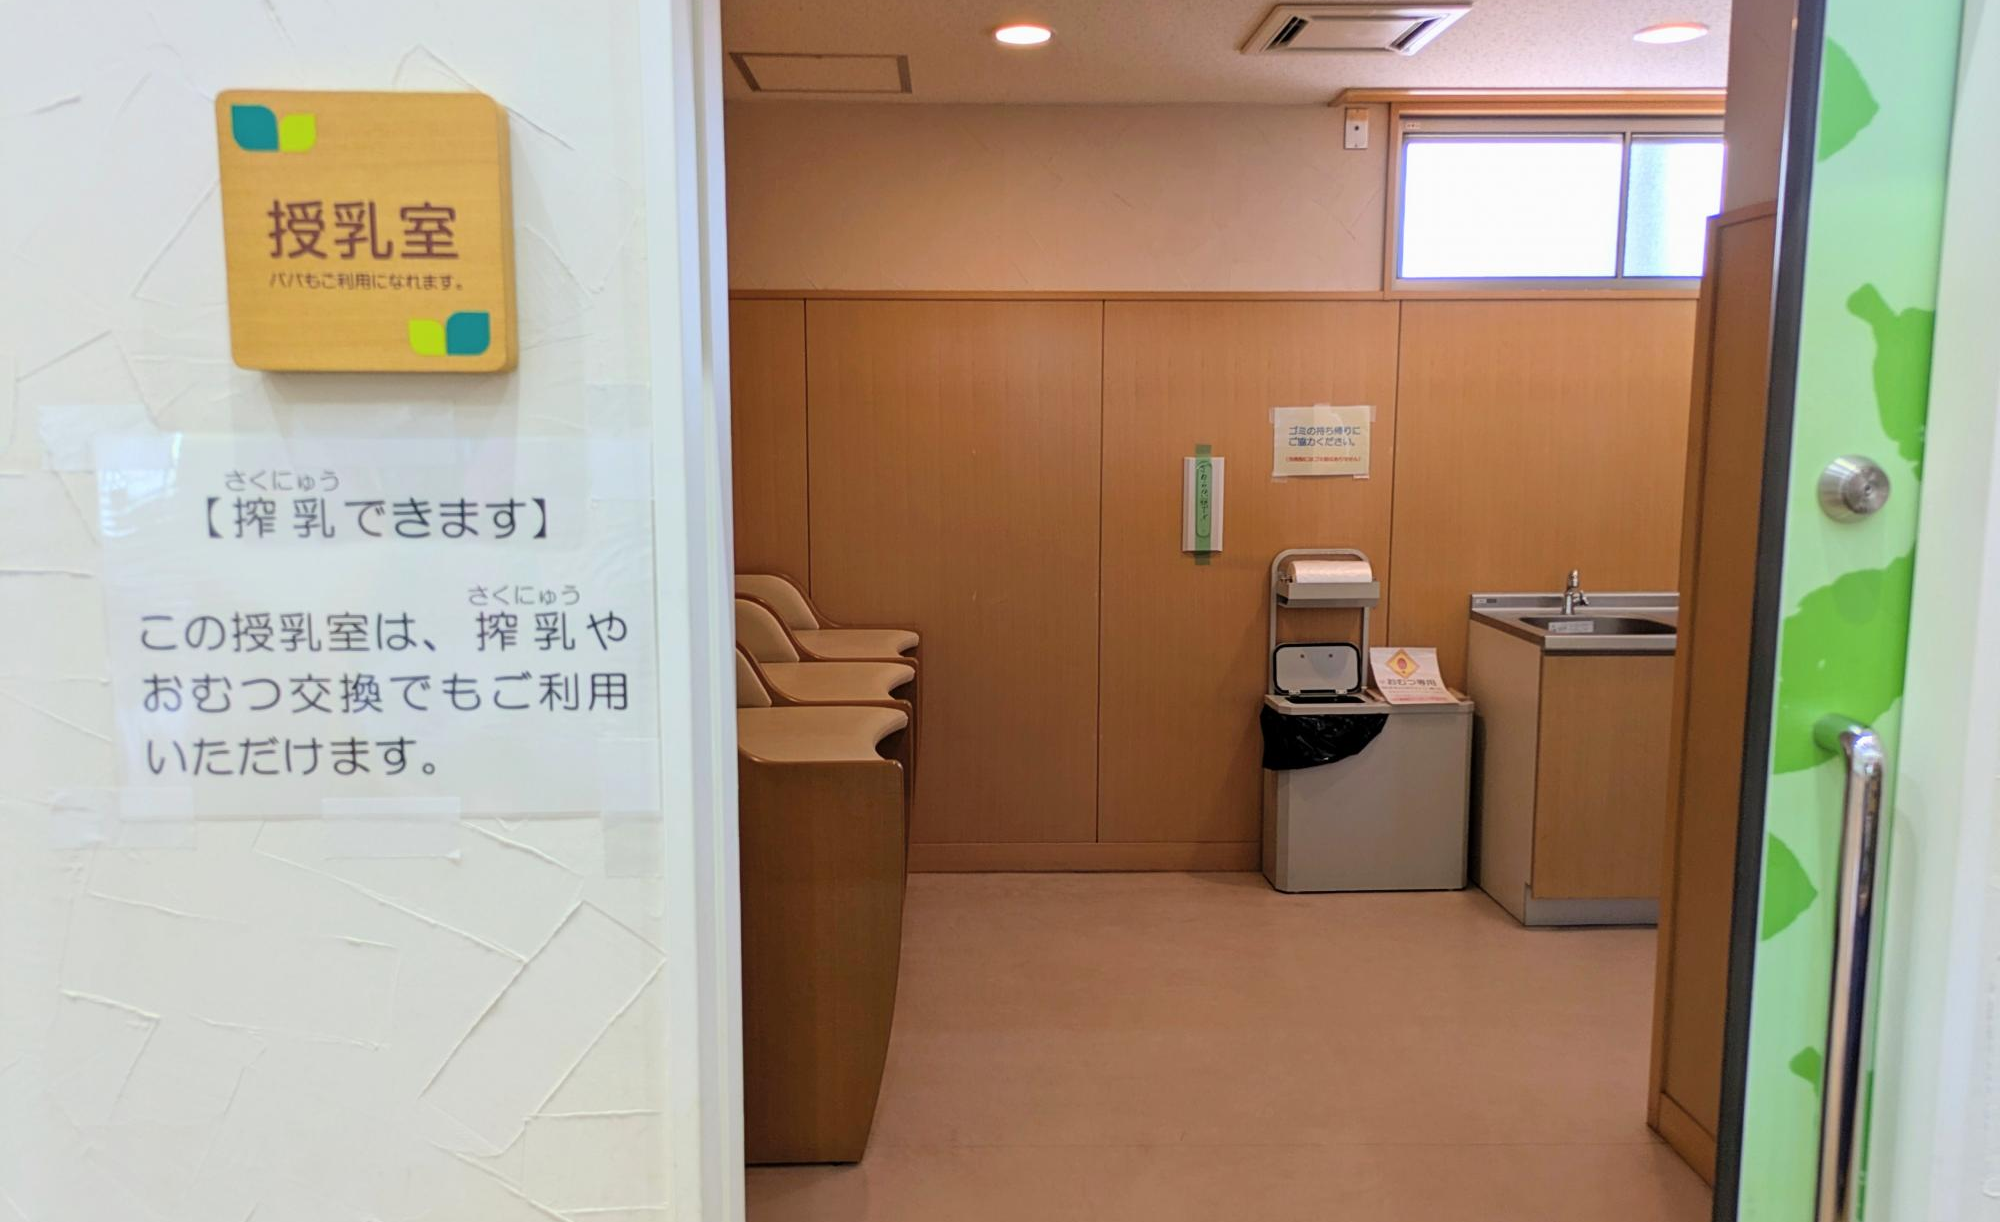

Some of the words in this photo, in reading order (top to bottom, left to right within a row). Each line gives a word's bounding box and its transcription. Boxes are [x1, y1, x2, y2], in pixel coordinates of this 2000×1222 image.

[267, 200, 459, 260] 授乳室
[225, 470, 340, 492] さくにゅう
[206, 496, 548, 540] 【搾乳できます】
[468, 584, 581, 607] さくにゅう
[140, 610, 628, 653] この授乳室は、搾乳や
[143, 670, 629, 714] おむつ交換でもご利用
[147, 736, 437, 776] いただけます。
